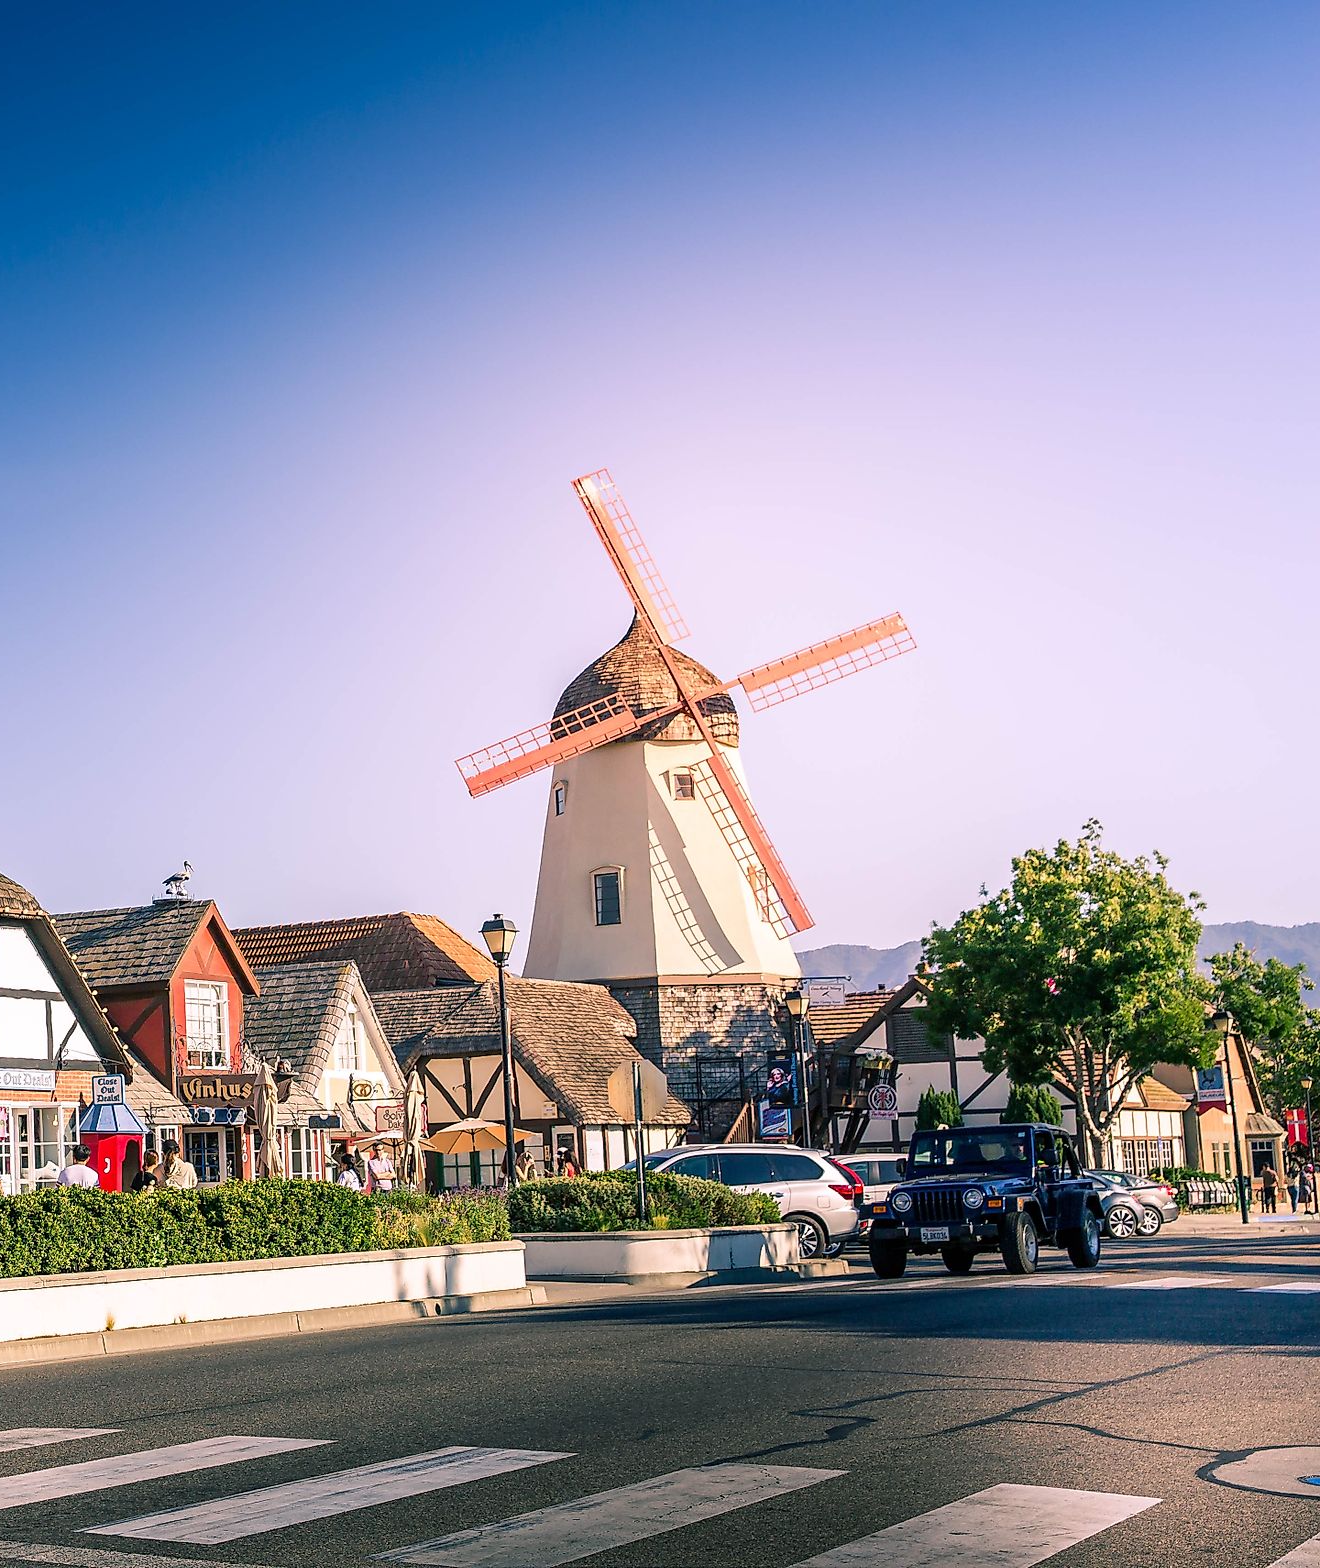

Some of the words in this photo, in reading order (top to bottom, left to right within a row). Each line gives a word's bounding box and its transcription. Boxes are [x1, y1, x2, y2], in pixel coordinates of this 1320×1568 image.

[3, 1072, 22, 1085] Out
[23, 1073, 53, 1087] Deals!
[97, 1078, 117, 1086] Close
[100, 1086, 115, 1094] Out
[182, 1077, 253, 1101] Vinhus
[96, 1094, 120, 1102] Deals!
